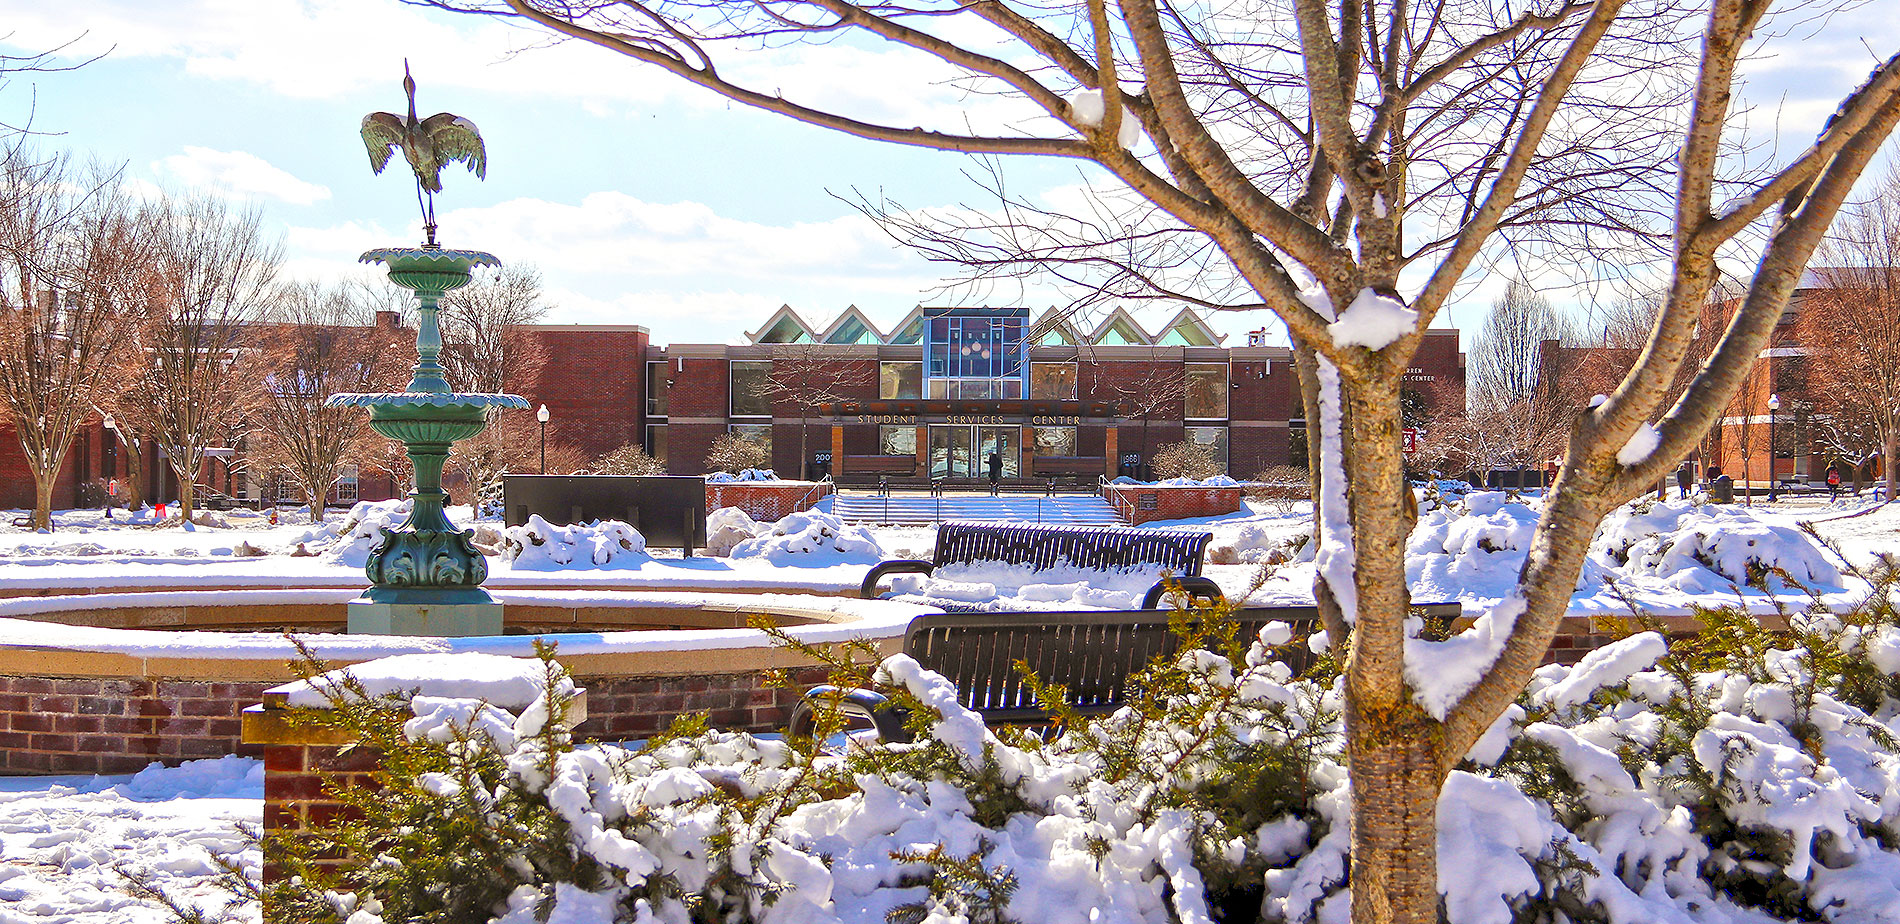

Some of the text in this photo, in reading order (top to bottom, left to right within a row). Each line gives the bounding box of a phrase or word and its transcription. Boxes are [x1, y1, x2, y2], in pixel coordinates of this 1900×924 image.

[857, 414, 1081, 425] STUDENT SERVICES CENTER
[815, 453, 833, 461] 200
